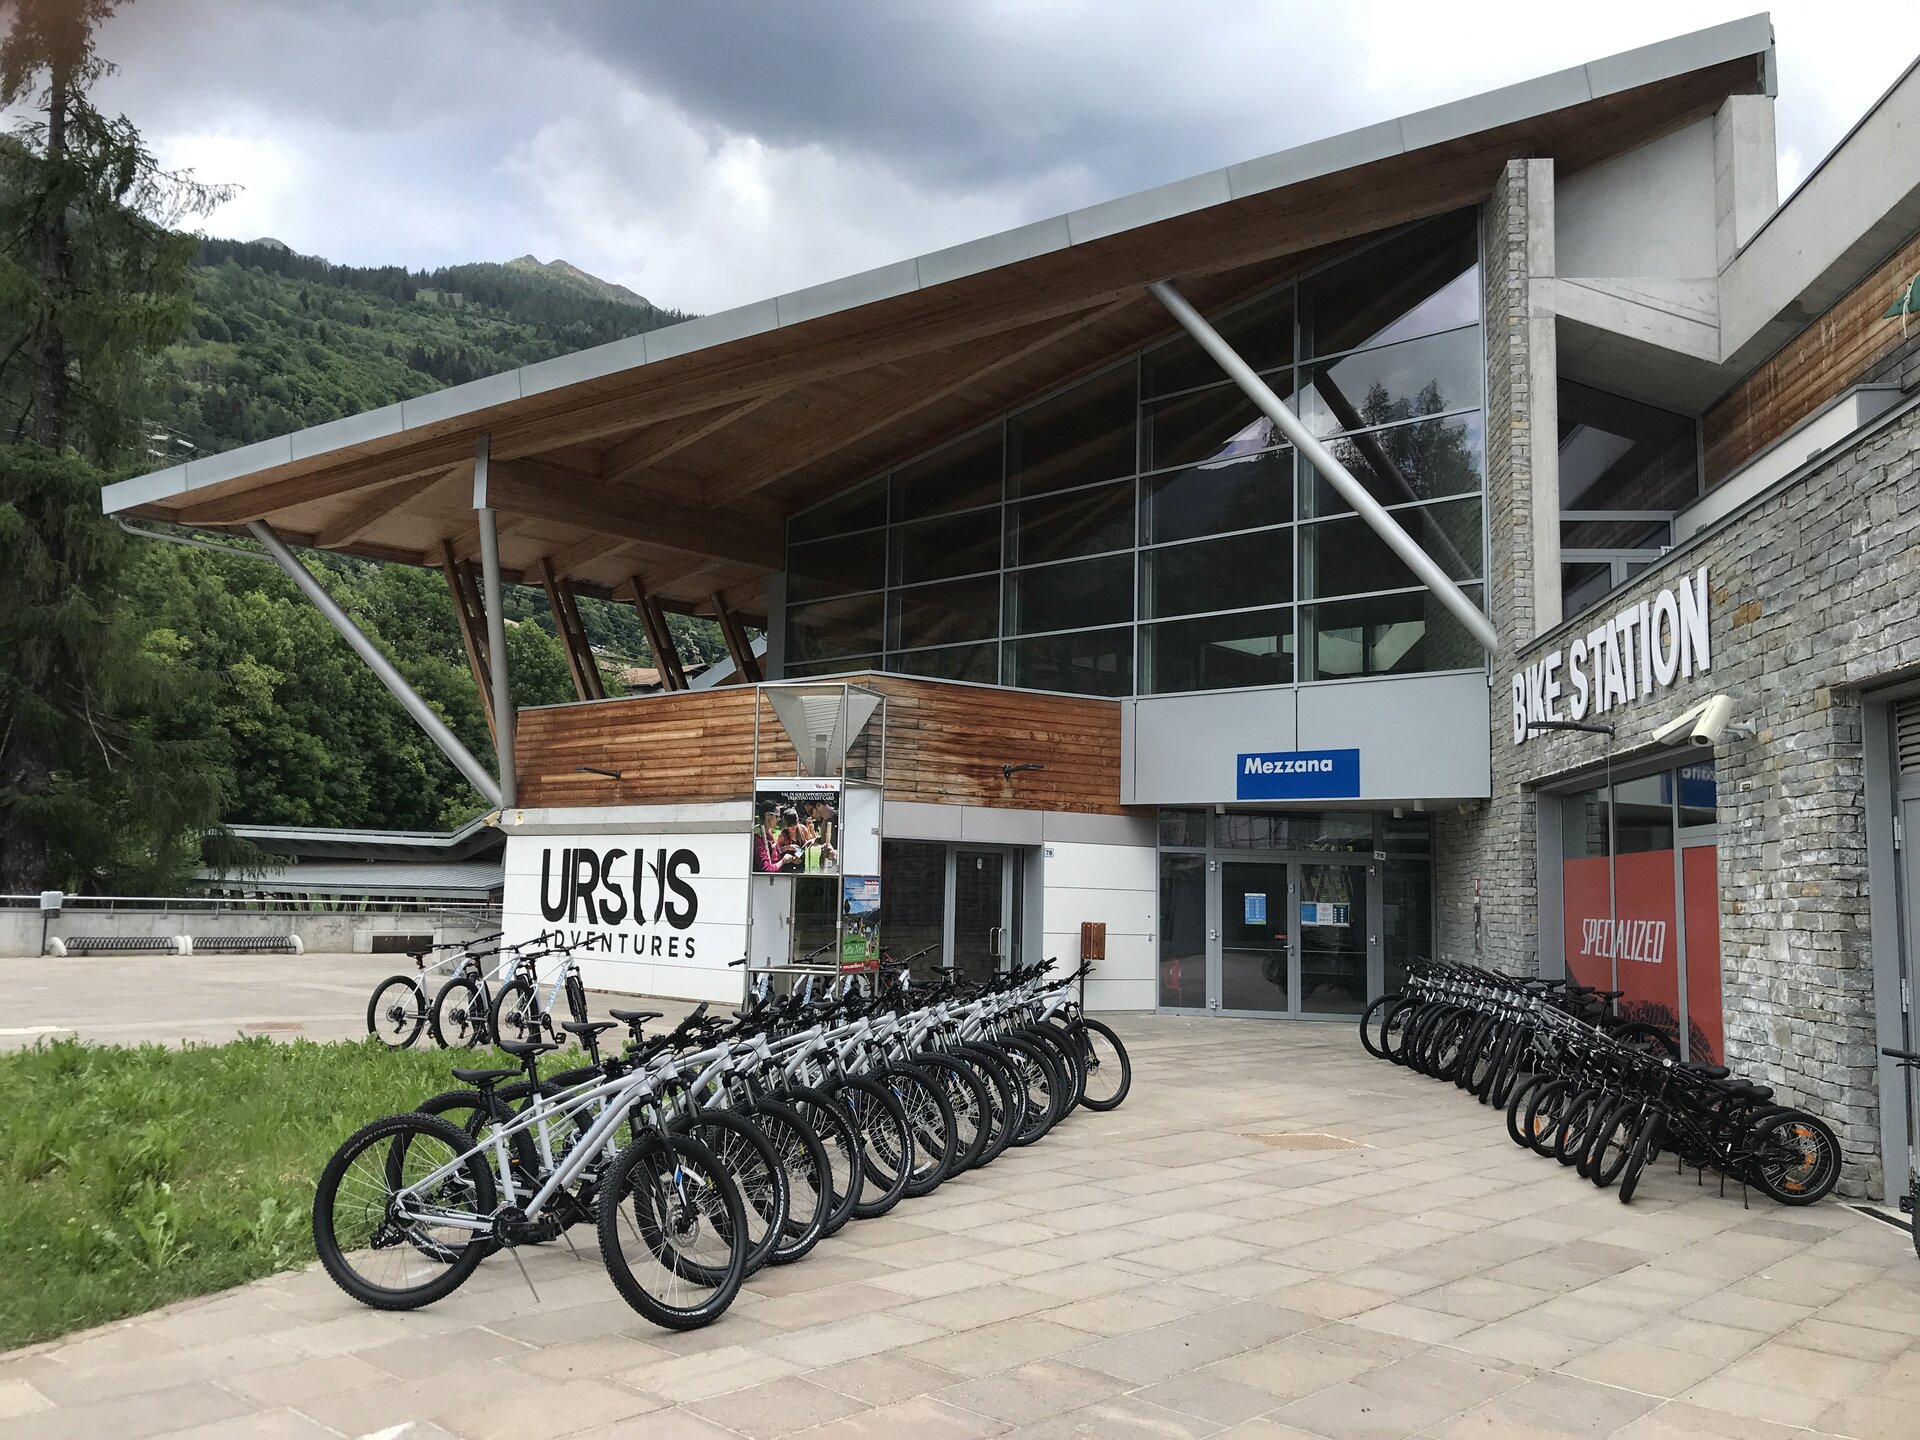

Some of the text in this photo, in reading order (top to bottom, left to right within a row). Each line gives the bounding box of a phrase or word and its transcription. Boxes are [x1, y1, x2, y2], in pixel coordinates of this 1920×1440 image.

[1512, 565, 1711, 745] BIKE STATION
[1244, 757, 1333, 775] Mezzana
[541, 848, 700, 930] URSUS
[537, 928, 695, 959] ADVENTURES
[1580, 918, 1666, 964] SPECIALIZED
